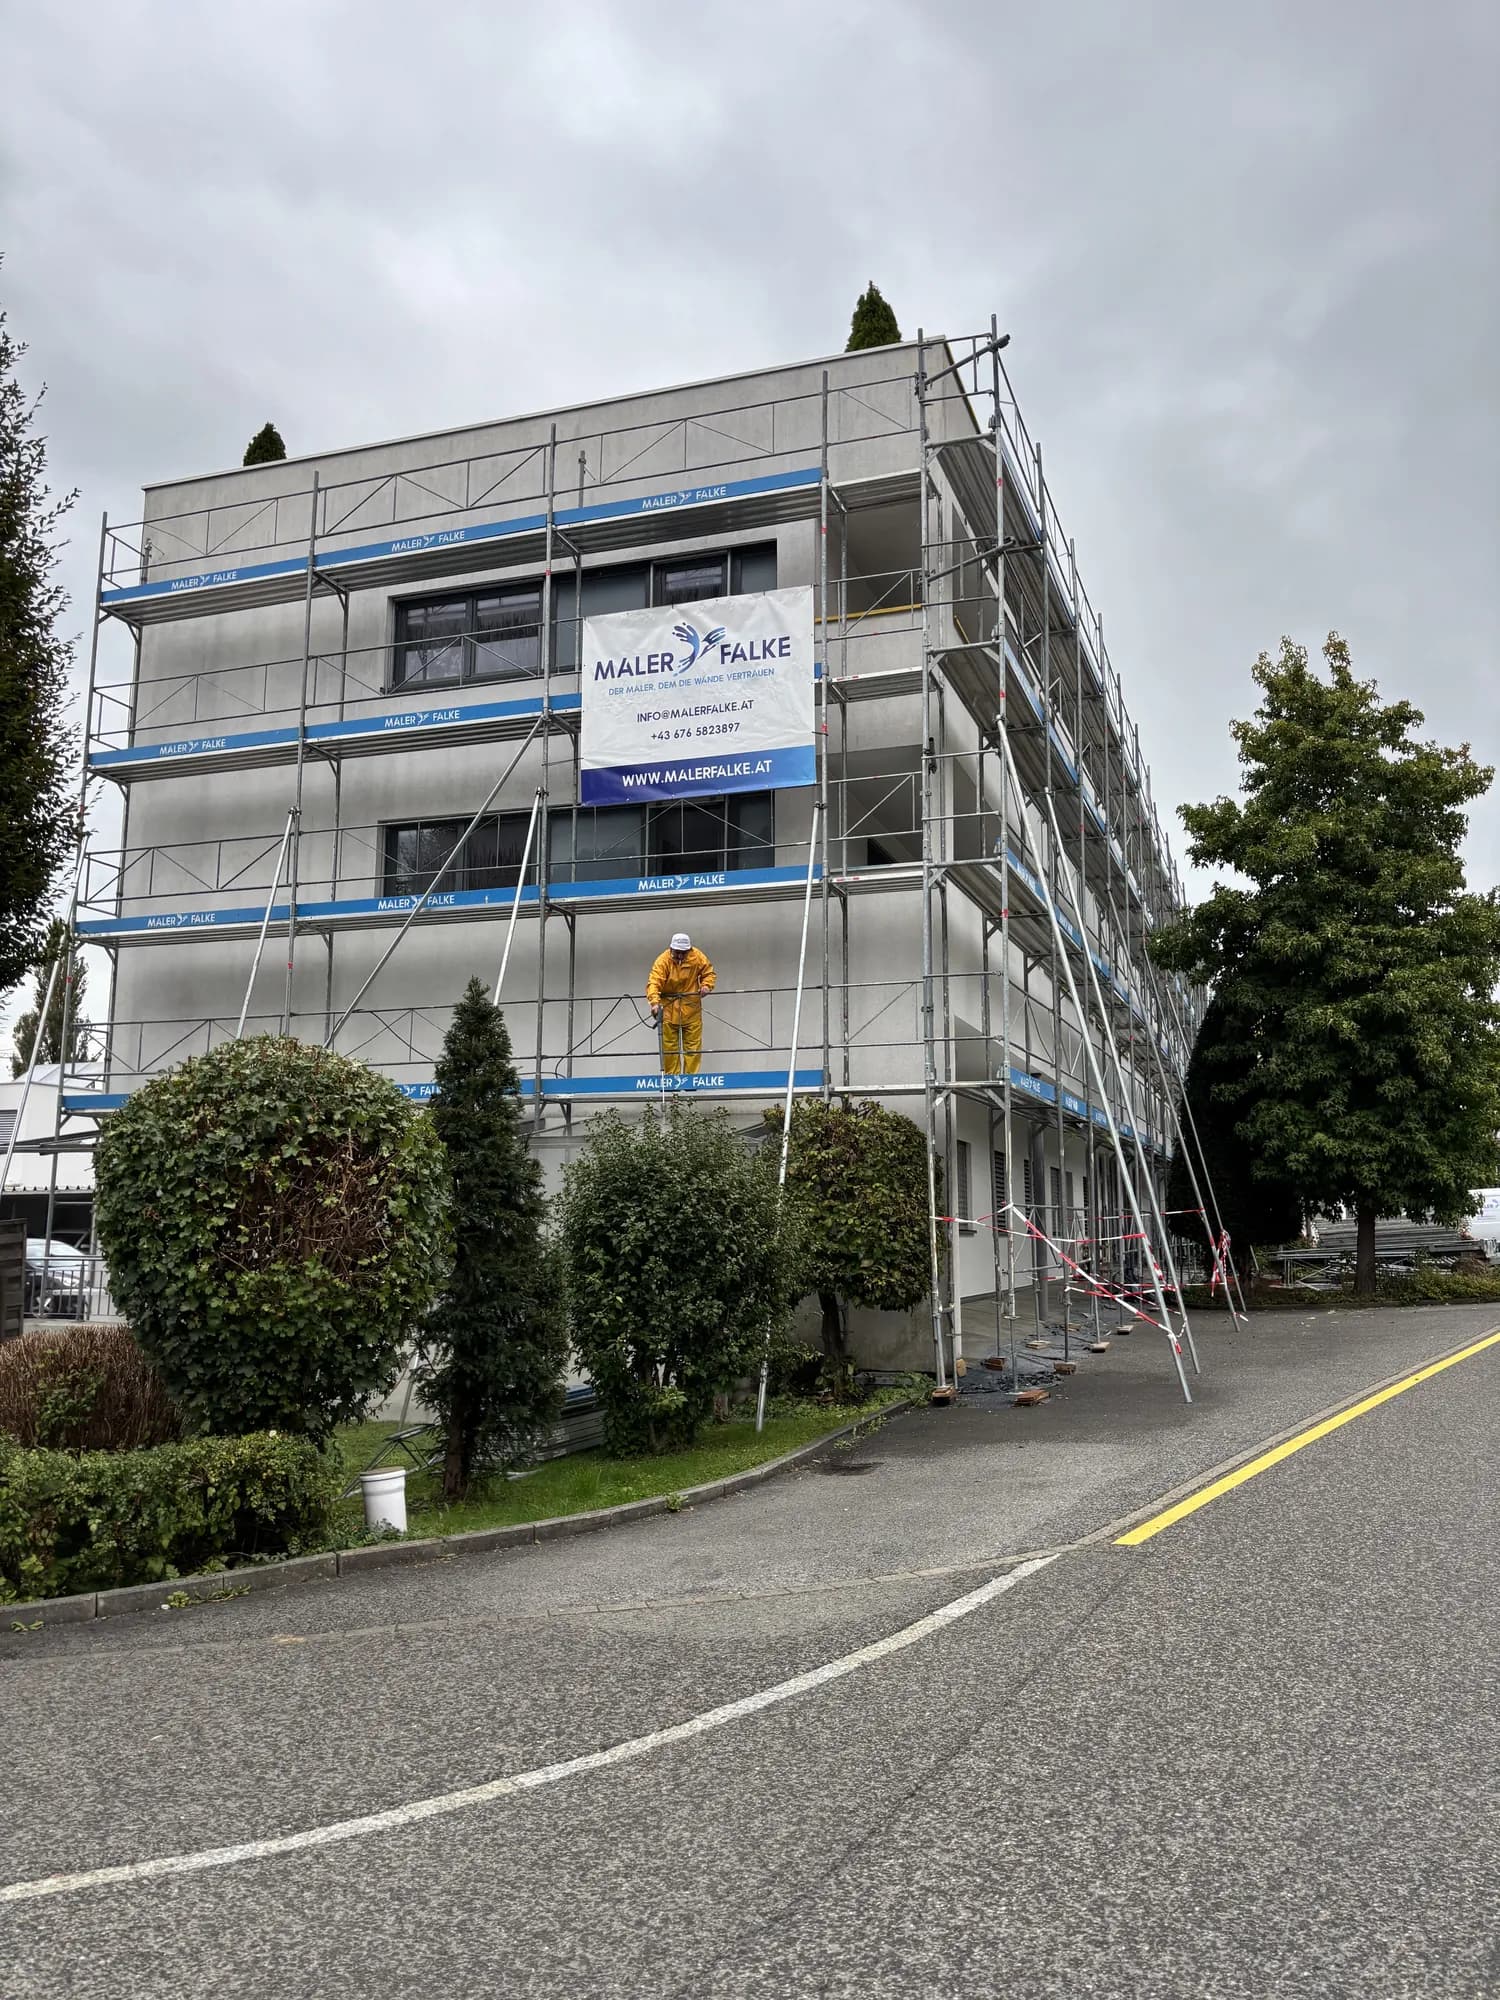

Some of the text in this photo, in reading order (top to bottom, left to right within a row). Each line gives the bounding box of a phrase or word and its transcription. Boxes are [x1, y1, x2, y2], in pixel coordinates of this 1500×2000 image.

[642, 486, 727, 509] MALER FALKE
[391, 530, 465, 552] MALER FALKE
[171, 570, 237, 591] MALER FALKE
[594, 636, 791, 681] MALER FALKE
[608, 687, 624, 696] DER
[658, 681, 677, 690] DEM
[679, 678, 692, 688] DIE
[726, 668, 775, 682] VERTRAUEN
[384, 709, 460, 729] MALER FALKE
[637, 699, 754, 723] INFO@MALERFALKE.AT
[651, 722, 740, 741] +43 676 5823897
[159, 738, 227, 756] MALER FALKE
[622, 759, 772, 787] WWW.MALERFALKE.AT
[638, 873, 725, 891] MALER FALKE
[377, 894, 455, 910] MALER FALKE
[147, 912, 216, 928] MALER FALKE
[420, 1085, 442, 1096] FALK
[636, 1075, 725, 1089] MALER FALKE
